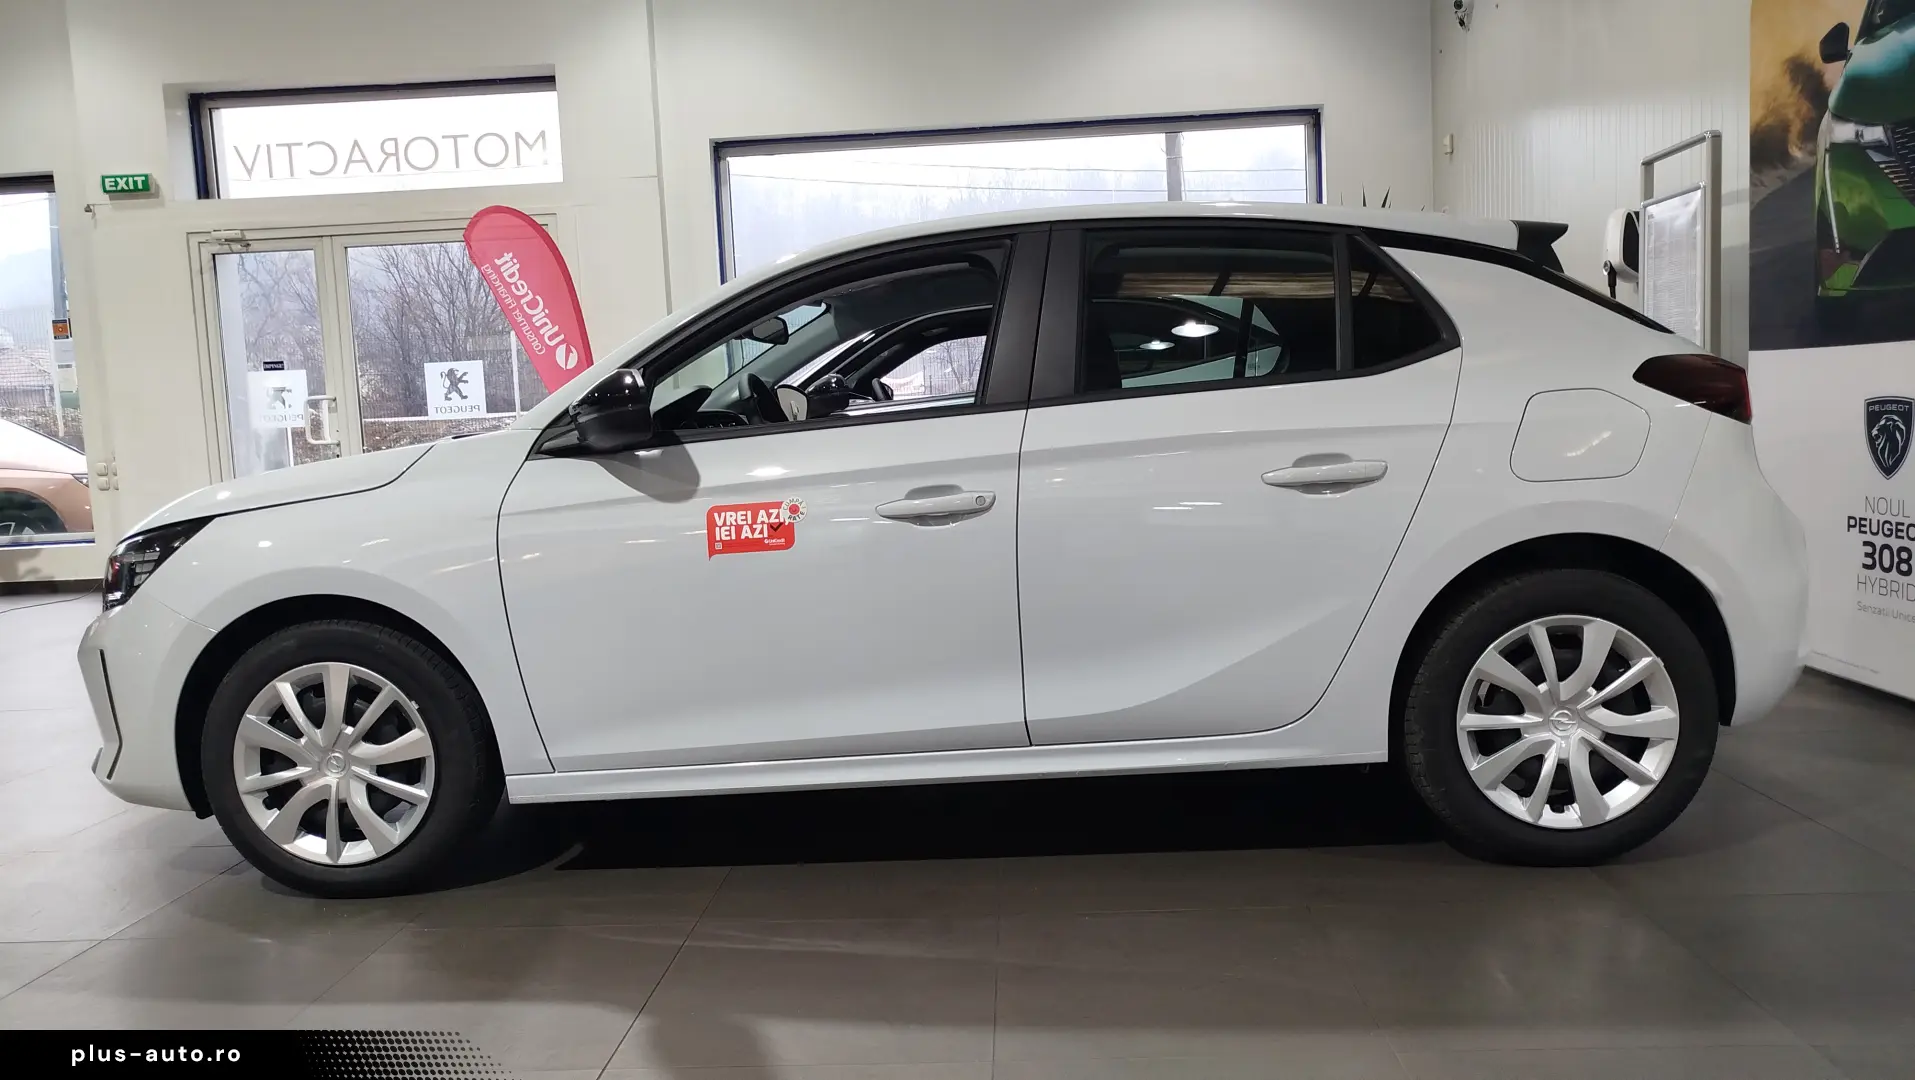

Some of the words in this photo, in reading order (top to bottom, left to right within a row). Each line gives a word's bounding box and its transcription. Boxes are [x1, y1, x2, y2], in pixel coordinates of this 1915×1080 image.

[104, 176, 146, 191] EXIT
[1868, 404, 1910, 412] PEUGEOT
[1864, 495, 1911, 518] NOUL
[714, 511, 752, 527] VREI
[787, 511, 805, 521] RATE
[715, 526, 736, 541] IEI
[740, 523, 769, 540] AZI
[1847, 515, 1915, 542] PEUGEO
[1861, 540, 1913, 577] 308
[1857, 573, 1915, 602] HYBRID
